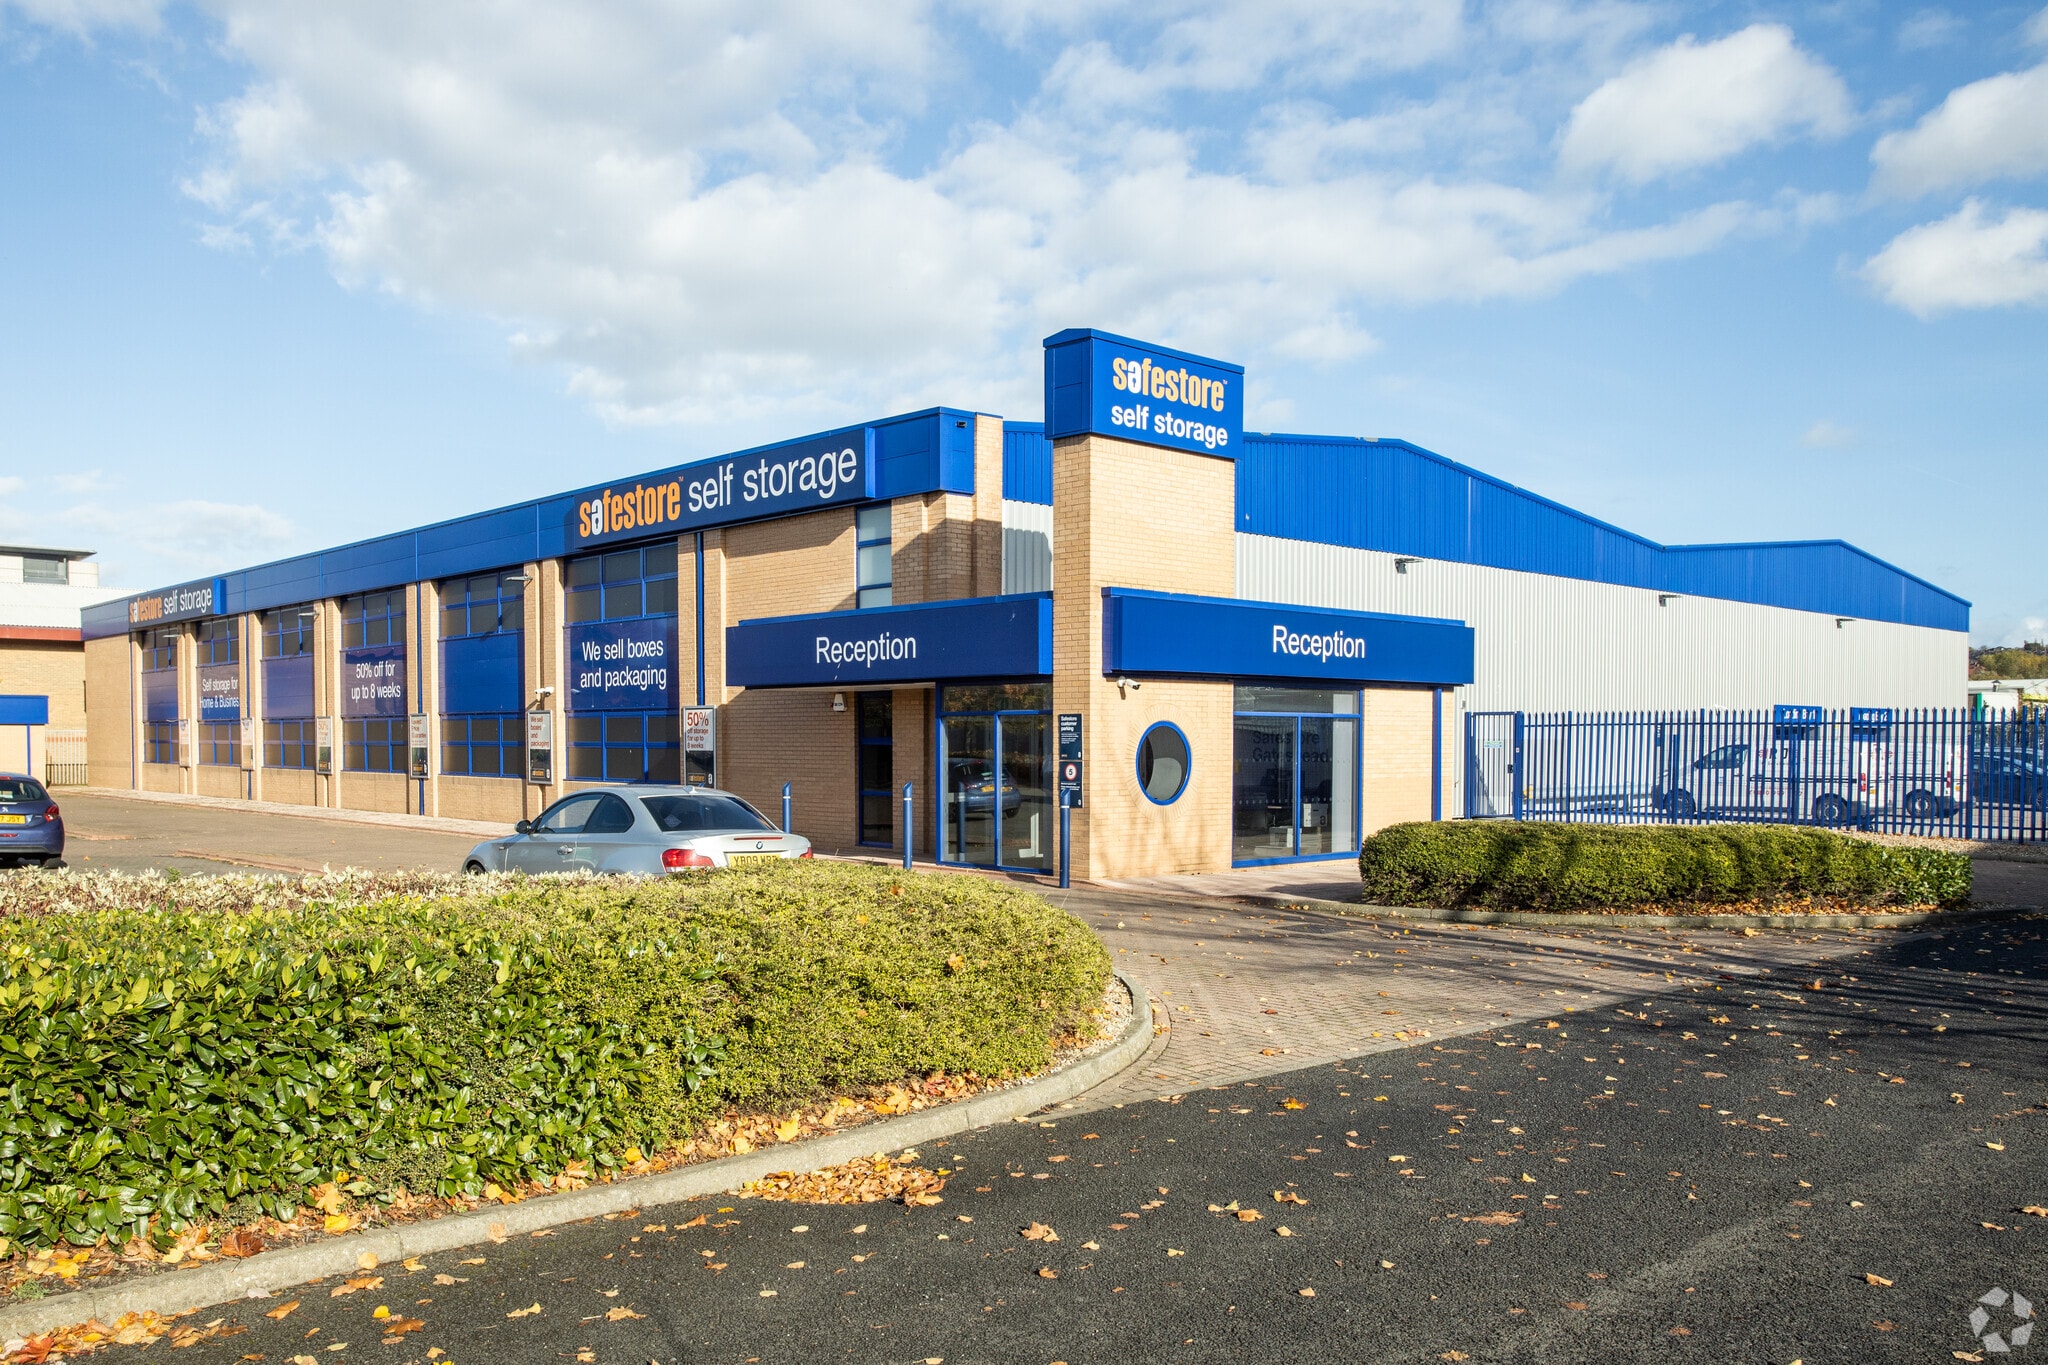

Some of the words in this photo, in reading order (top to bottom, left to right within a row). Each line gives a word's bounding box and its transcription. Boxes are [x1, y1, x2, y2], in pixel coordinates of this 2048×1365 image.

[1112, 357, 1225, 412] safestore
[1111, 404, 1150, 430] self
[1153, 411, 1228, 449] storage
[579, 481, 681, 538] safestore
[688, 463, 734, 512] self
[743, 447, 857, 501] storage
[129, 596, 163, 623] safestore
[164, 589, 178, 614] self
[180, 588, 212, 613] storage
[582, 641, 601, 661] We
[604, 638, 624, 660] sell
[627, 638, 664, 659] boxes
[816, 631, 916, 668] Reception
[1272, 624, 1365, 663] Reception
[356, 661, 373, 679] 50%
[373, 660, 384, 677] off
[385, 660, 395, 677] for
[580, 667, 602, 689] and
[605, 664, 667, 692] packaging
[202, 678, 212, 691] Self
[212, 679, 230, 693] storage
[230, 676, 239, 690] for
[351, 687, 361, 703] up
[361, 684, 369, 699] to
[370, 683, 376, 699] 8
[376, 682, 401, 698] weeks
[219, 694, 240, 708] Busines
[687, 711, 709, 727] 50%
[1068, 768, 1073, 776] 5
